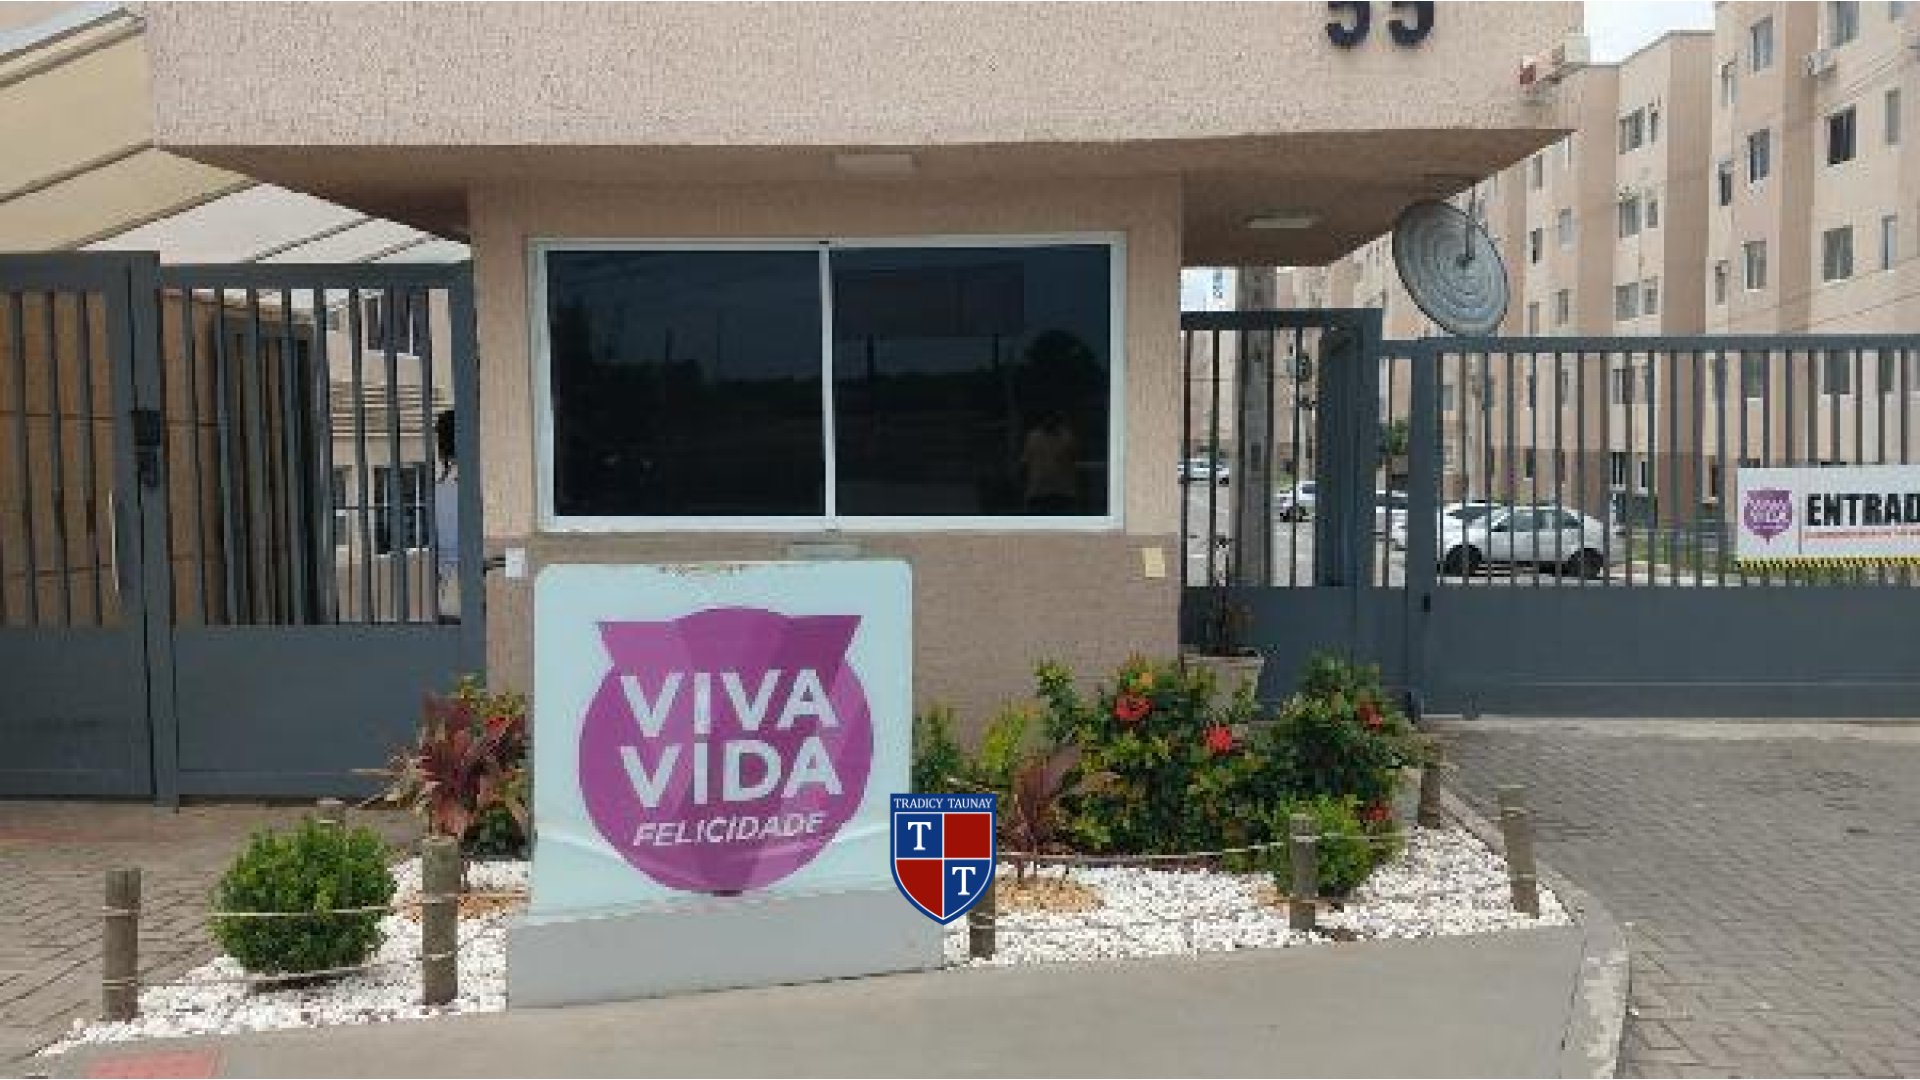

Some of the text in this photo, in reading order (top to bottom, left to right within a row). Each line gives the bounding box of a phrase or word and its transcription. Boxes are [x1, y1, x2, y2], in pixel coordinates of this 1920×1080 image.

[620, 669, 838, 737] VIVA
[620, 736, 843, 807] VIDA
[633, 812, 827, 846] FELICIDADE
